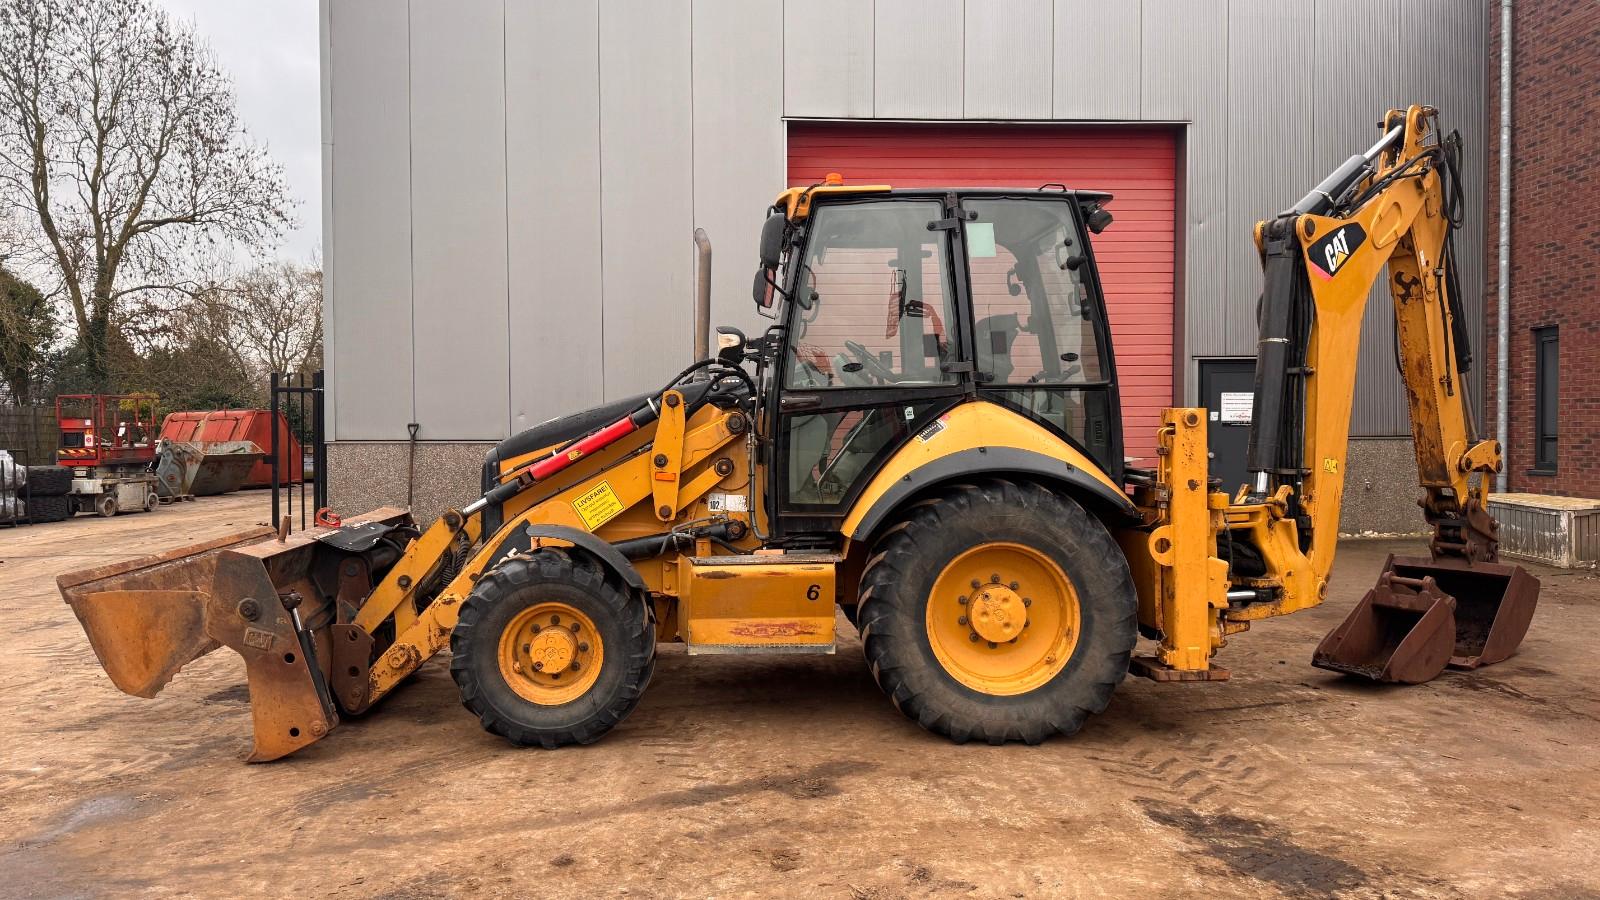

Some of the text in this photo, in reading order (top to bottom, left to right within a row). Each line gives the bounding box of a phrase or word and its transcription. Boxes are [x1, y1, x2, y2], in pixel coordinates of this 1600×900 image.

[1325, 228, 1349, 272] CAT
[577, 485, 609, 508] LIVSFARE!
[806, 584, 821, 601] 6
